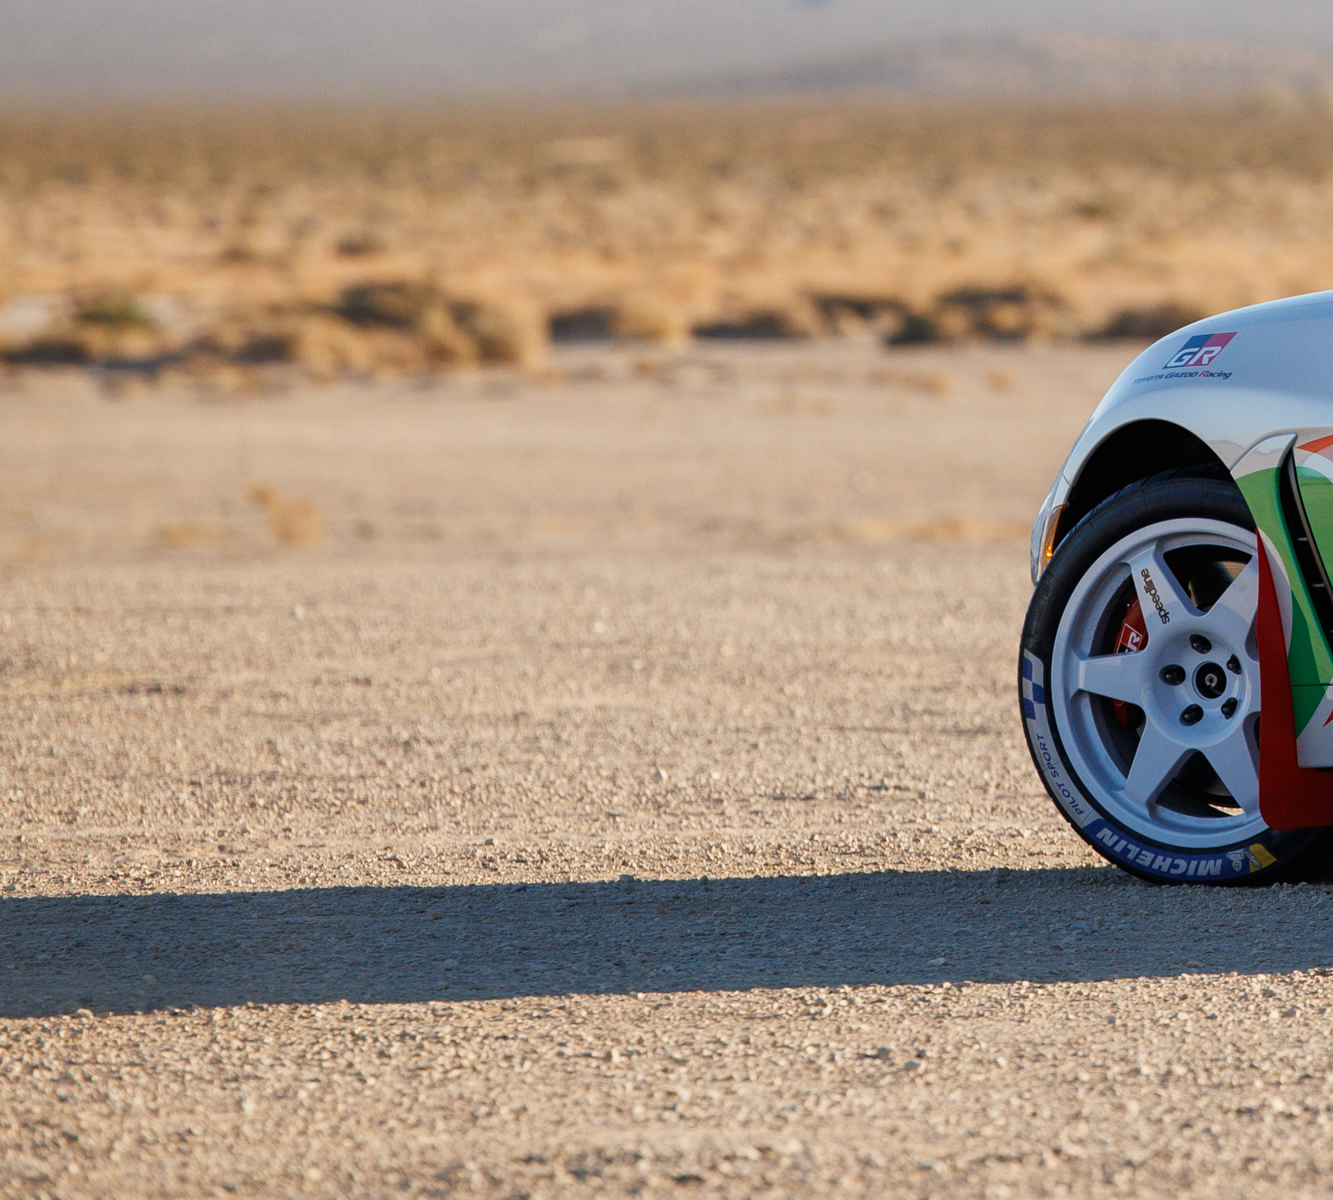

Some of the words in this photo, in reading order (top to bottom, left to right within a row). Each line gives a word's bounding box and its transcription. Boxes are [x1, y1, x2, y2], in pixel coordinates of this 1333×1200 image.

[1165, 346, 1222, 368] GR
[1132, 374, 1164, 385] TOYOTA
[1164, 371, 1198, 380] GAZOO
[1198, 370, 1232, 380] Racing
[1141, 568, 1170, 624] speedline
[1036, 733, 1060, 778] SPORT
[1056, 780, 1085, 816] PILOT
[1096, 827, 1224, 876] MICHELIN
